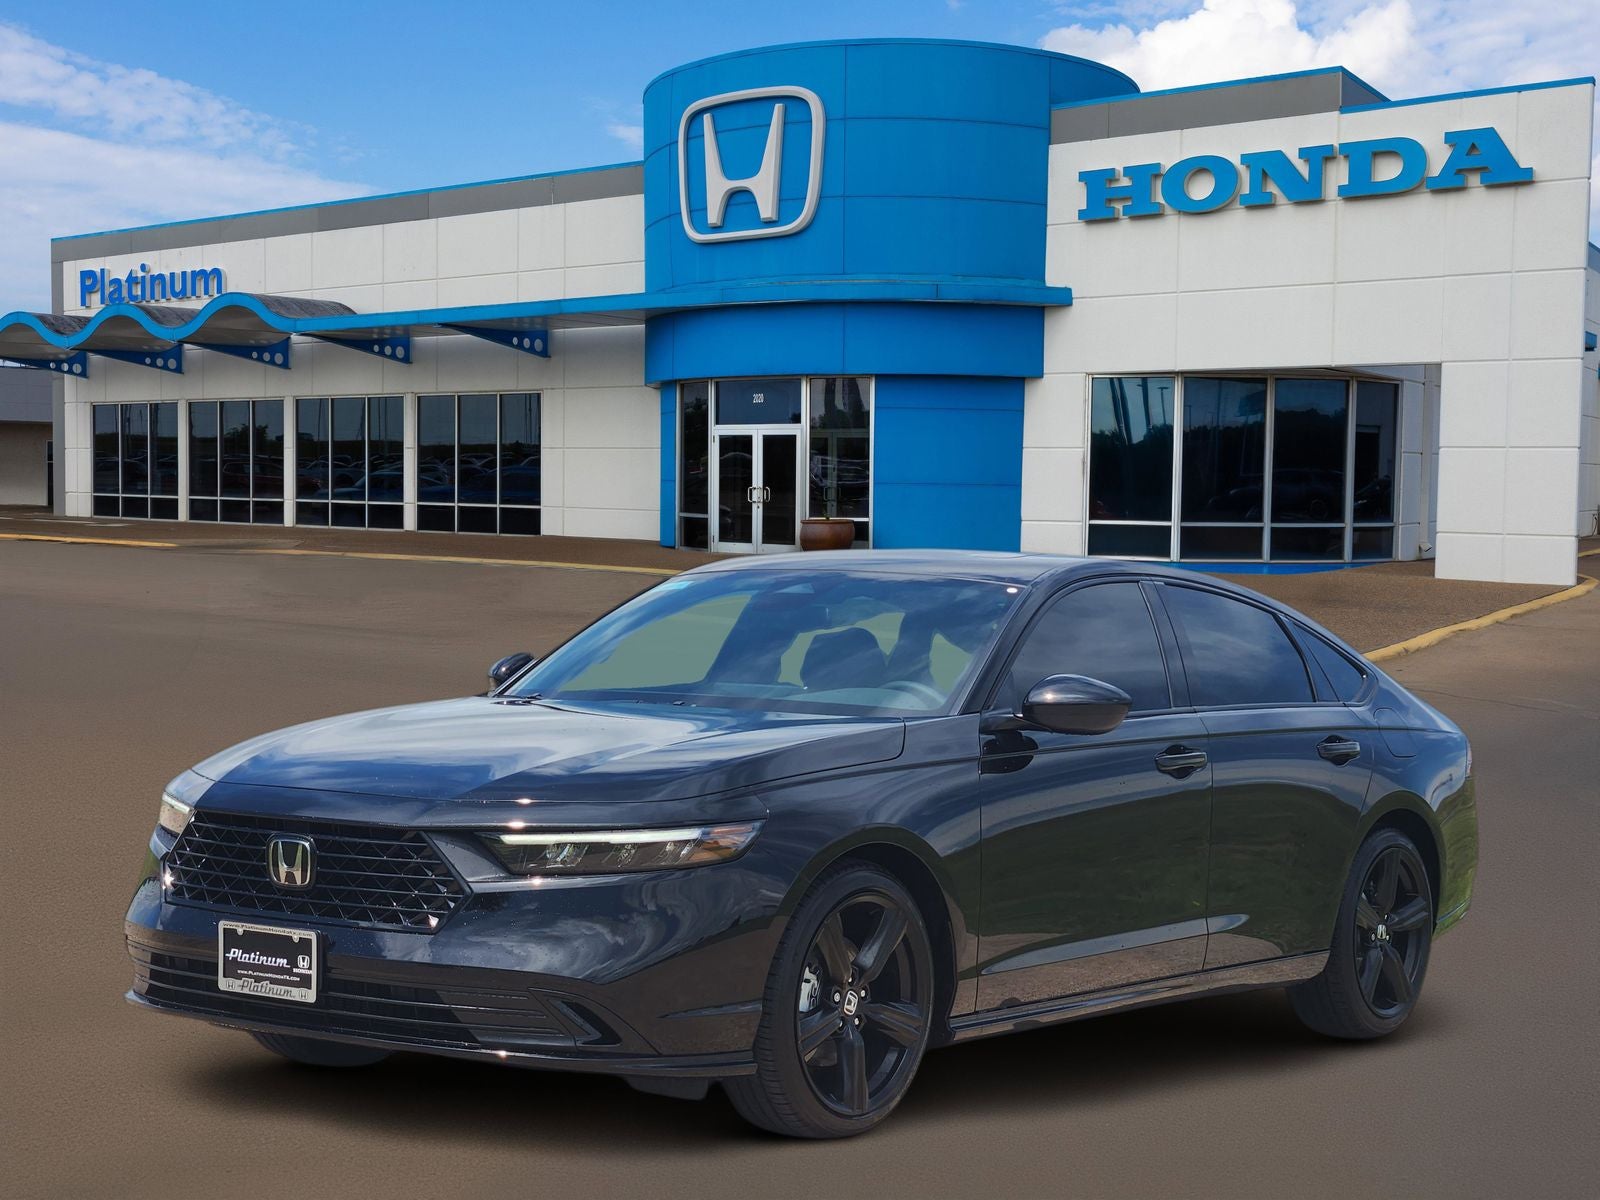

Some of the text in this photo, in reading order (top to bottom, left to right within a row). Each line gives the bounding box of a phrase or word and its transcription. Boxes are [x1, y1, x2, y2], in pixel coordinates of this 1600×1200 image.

[1078, 126, 1535, 222] HONDA
[80, 262, 224, 307] Platinum
[225, 948, 291, 968] Platinum
[238, 978, 296, 998] Platinum
